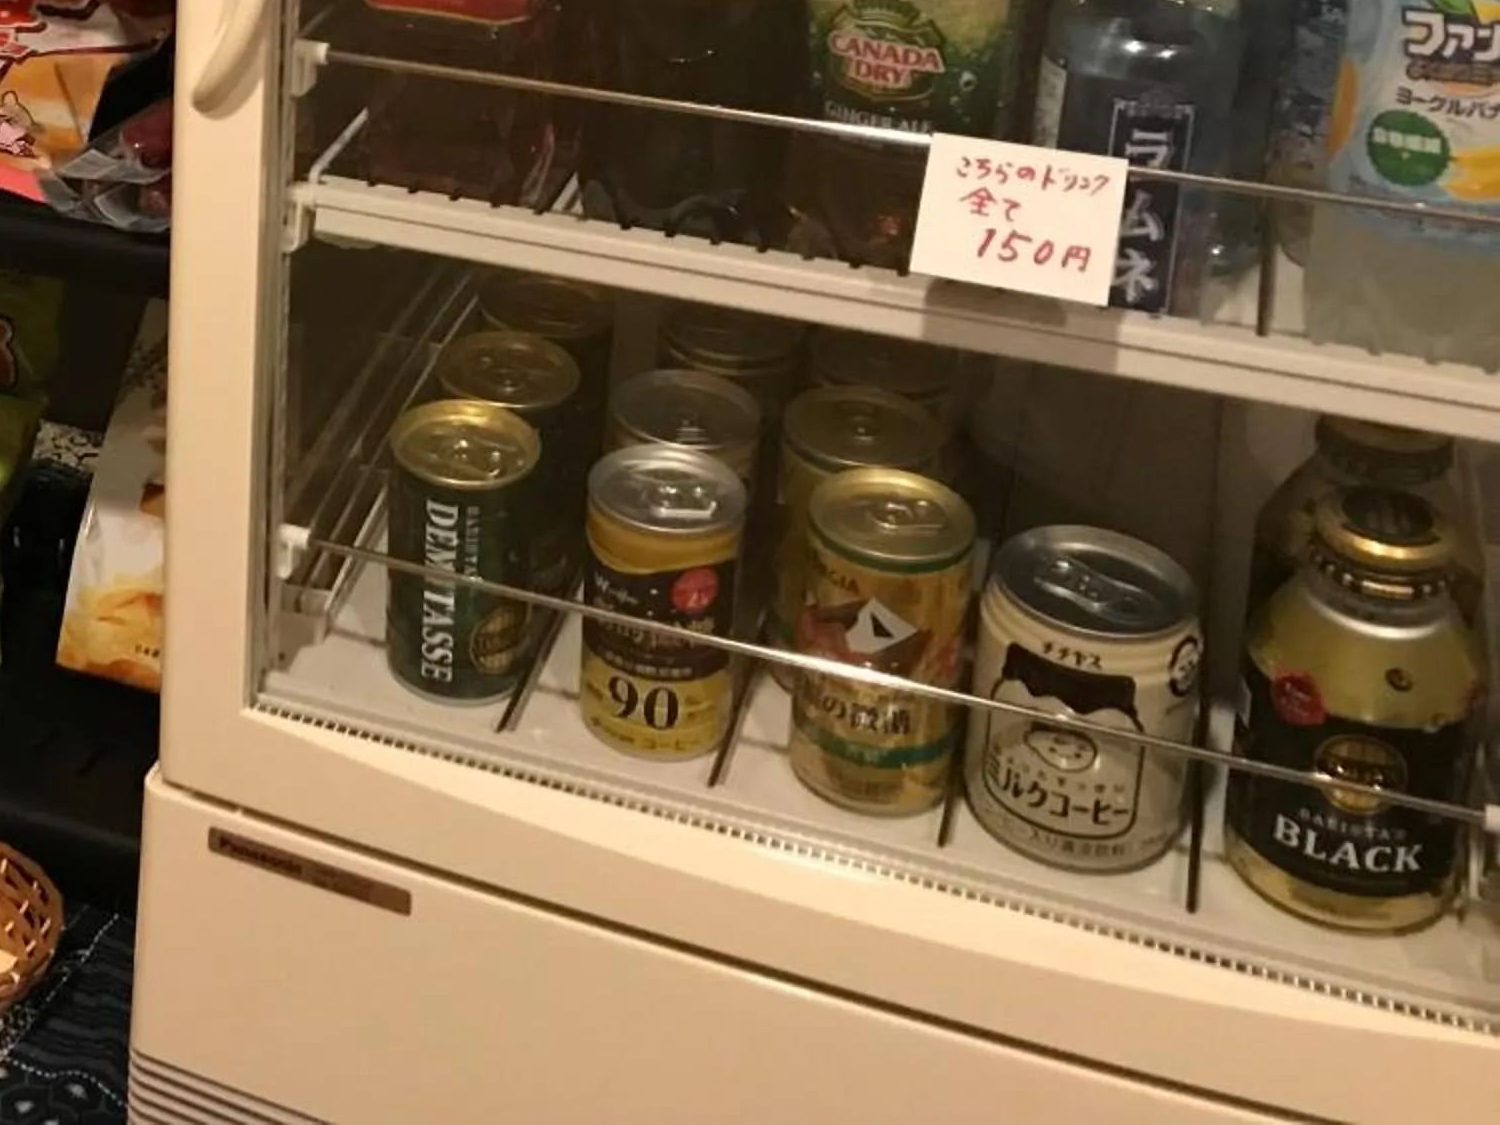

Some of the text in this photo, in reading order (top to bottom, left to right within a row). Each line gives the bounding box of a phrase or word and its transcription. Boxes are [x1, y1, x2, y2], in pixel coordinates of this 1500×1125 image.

[830, 31, 943, 71] CANADA
[853, 60, 907, 85] DRY
[955, 155, 1110, 192] こちらのドリンク
[959, 186, 1022, 223] 全て
[975, 227, 1093, 273] 150円
[608, 676, 680, 731] 90
[986, 749, 1131, 826] ミルクコーヒー
[1273, 812, 1423, 873] BLACK
